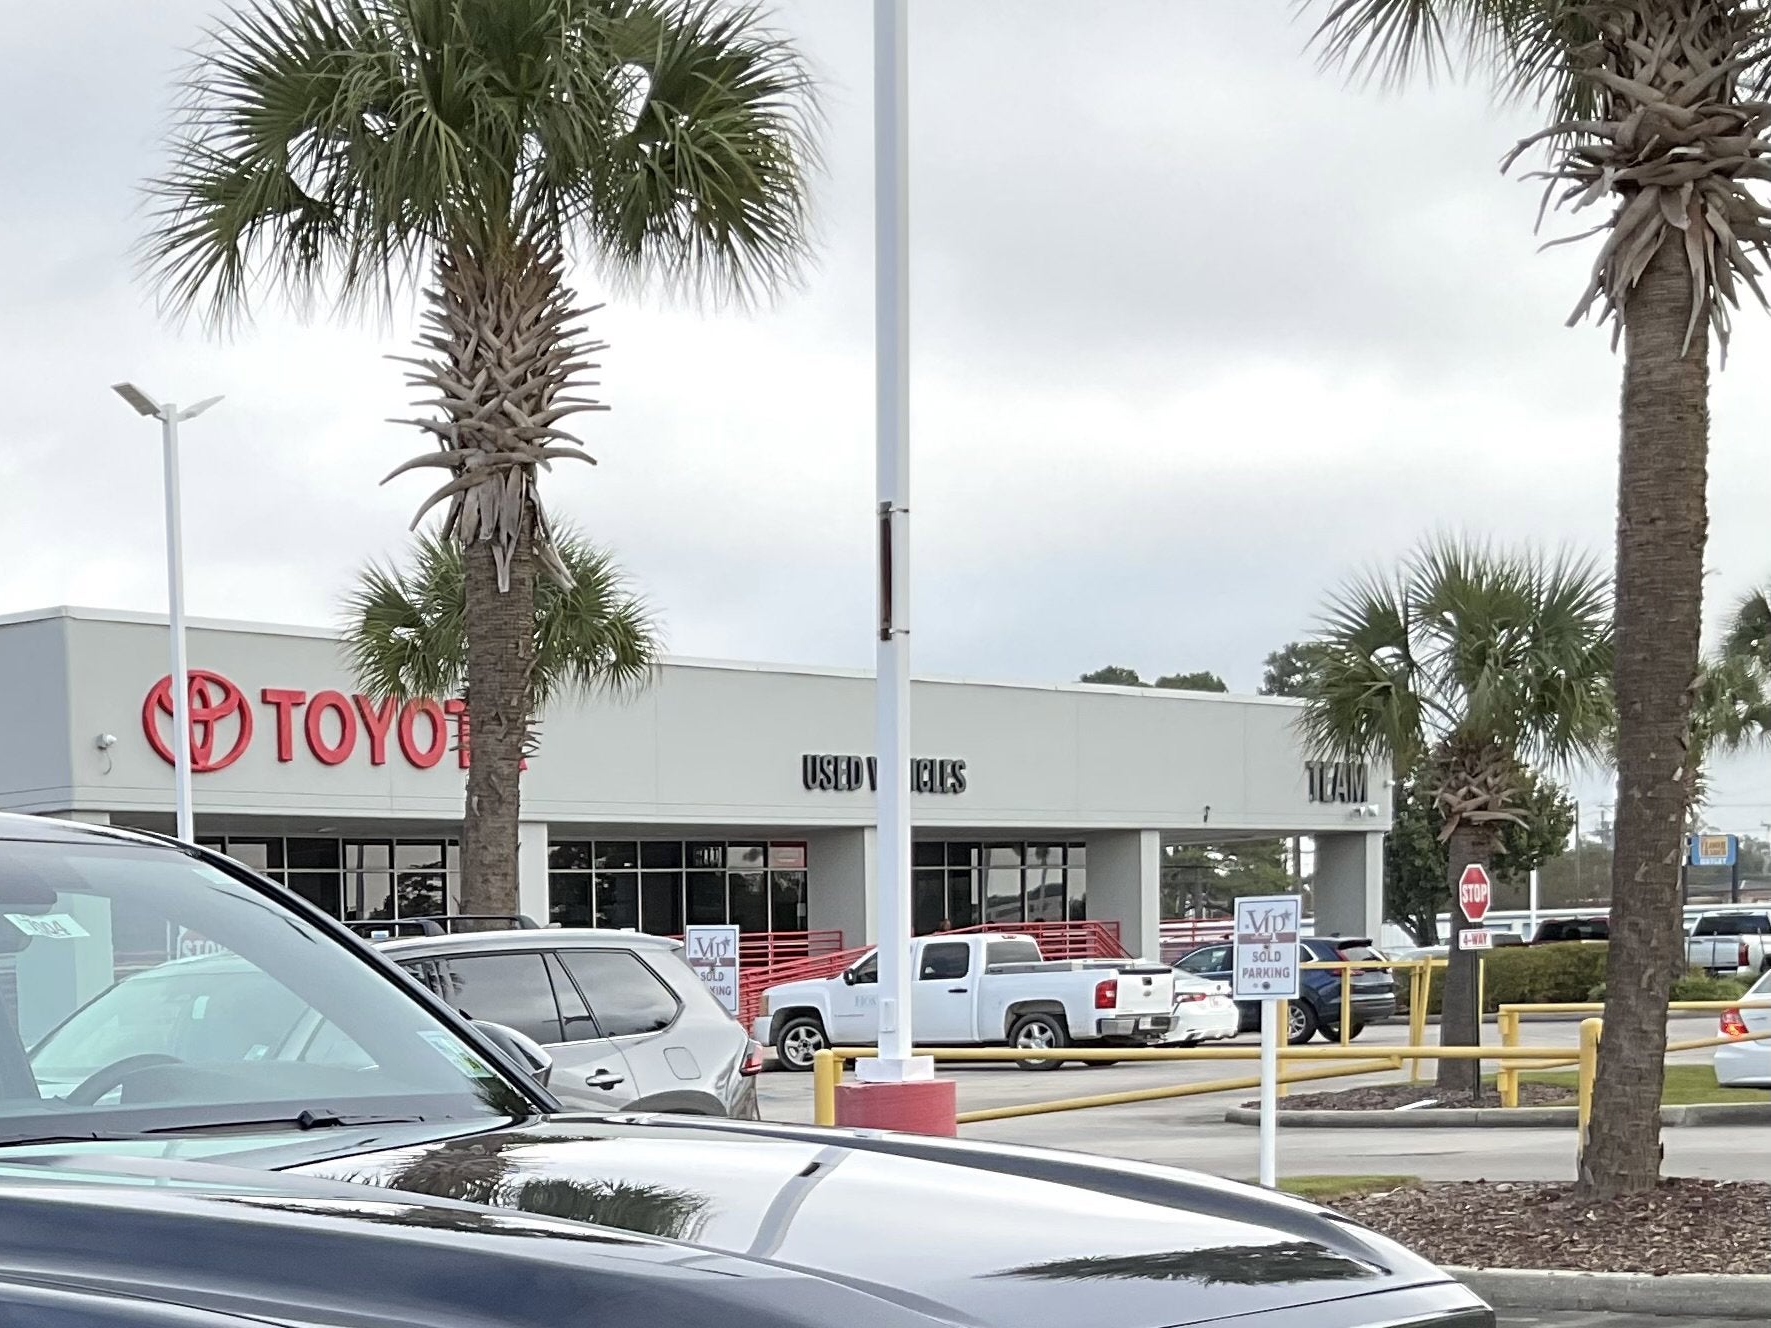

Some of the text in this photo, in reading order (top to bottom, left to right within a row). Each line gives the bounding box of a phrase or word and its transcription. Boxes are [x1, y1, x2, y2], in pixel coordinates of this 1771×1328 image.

[261, 688, 527, 770] TOYOT
[802, 754, 967, 794] USED VICLES
[1305, 760, 1368, 803] TEAM
[1461, 883, 1488, 904] STOP
[182, 939, 230, 958] STO
[1462, 932, 1489, 946] 4-WAY
[1252, 950, 1282, 963] SOLD
[700, 971, 725, 982] SOLD
[1242, 966, 1290, 979] PARKING
